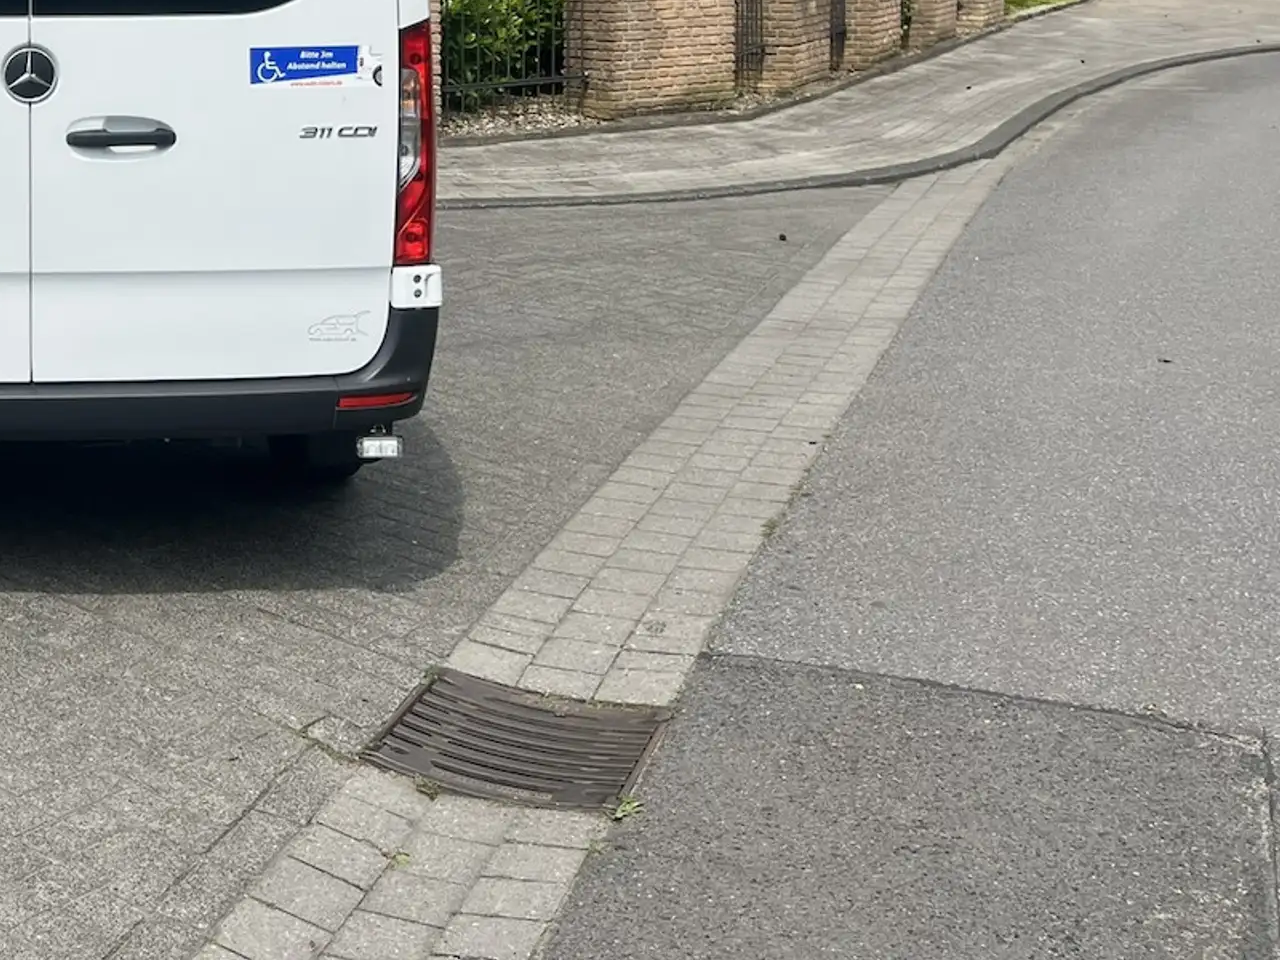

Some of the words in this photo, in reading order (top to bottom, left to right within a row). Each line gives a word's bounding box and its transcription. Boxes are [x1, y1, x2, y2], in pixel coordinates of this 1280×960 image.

[300, 50, 320, 59] Bitte
[320, 50, 334, 59] 3m
[286, 61, 320, 71] Abstand
[321, 61, 347, 70] halten
[299, 126, 333, 139] 311
[338, 126, 378, 138] CDI
